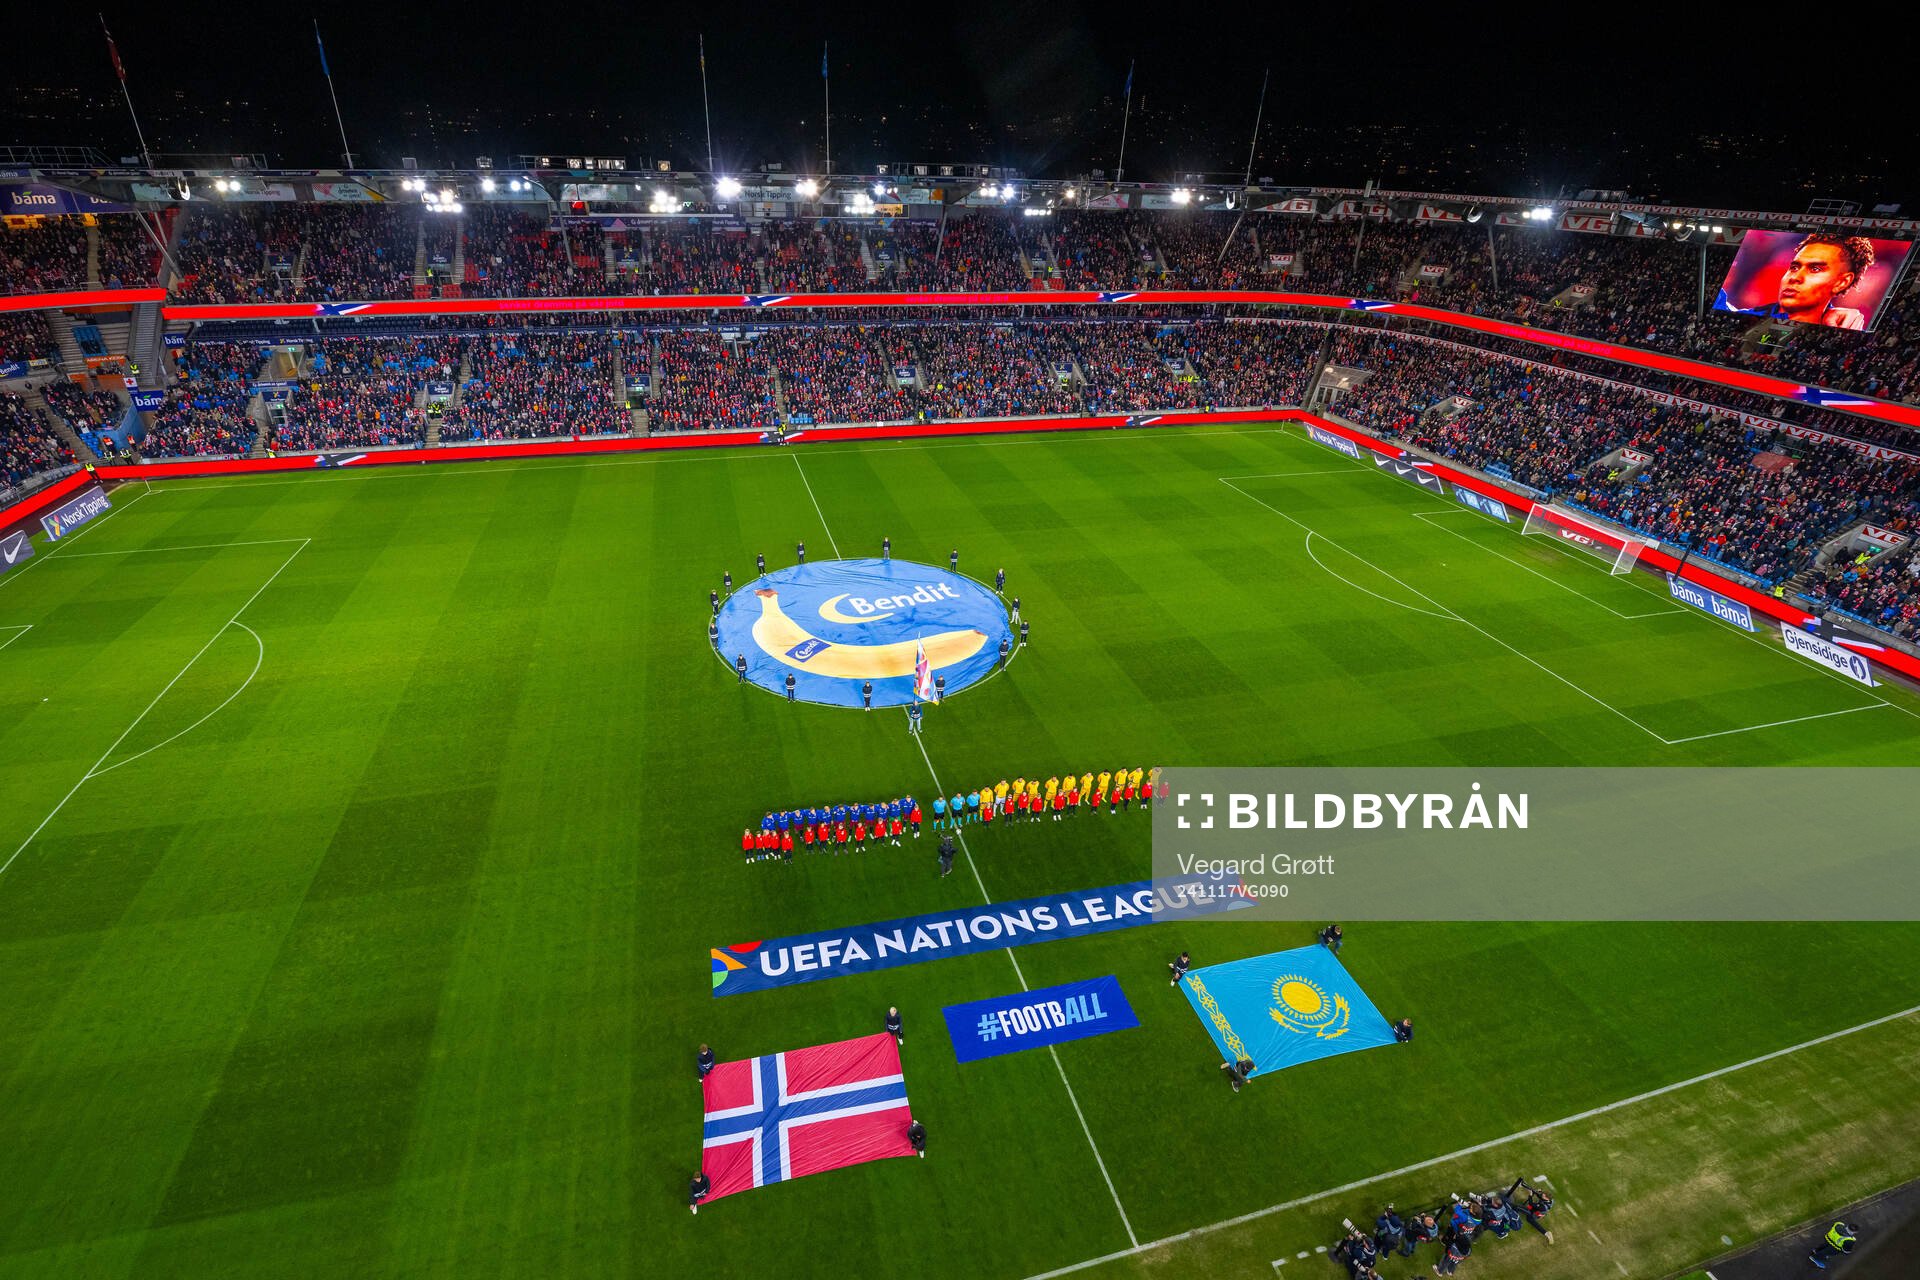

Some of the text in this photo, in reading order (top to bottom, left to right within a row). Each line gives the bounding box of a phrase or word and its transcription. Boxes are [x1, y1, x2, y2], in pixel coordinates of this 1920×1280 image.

[1563, 216, 1609, 232] VG
[165, 335, 186, 345] bam
[135, 395, 162, 407] bam
[61, 495, 108, 527] Norsk Tipping
[1560, 529, 1592, 545] VG
[848, 583, 960, 615] Bendit
[1670, 577, 1749, 628] bama bama
[1785, 628, 1848, 668] Gjensidige
[760, 882, 1215, 976] UEFA NATIONS LEAGUE
[977, 992, 1108, 1041] #FOOTBALL
